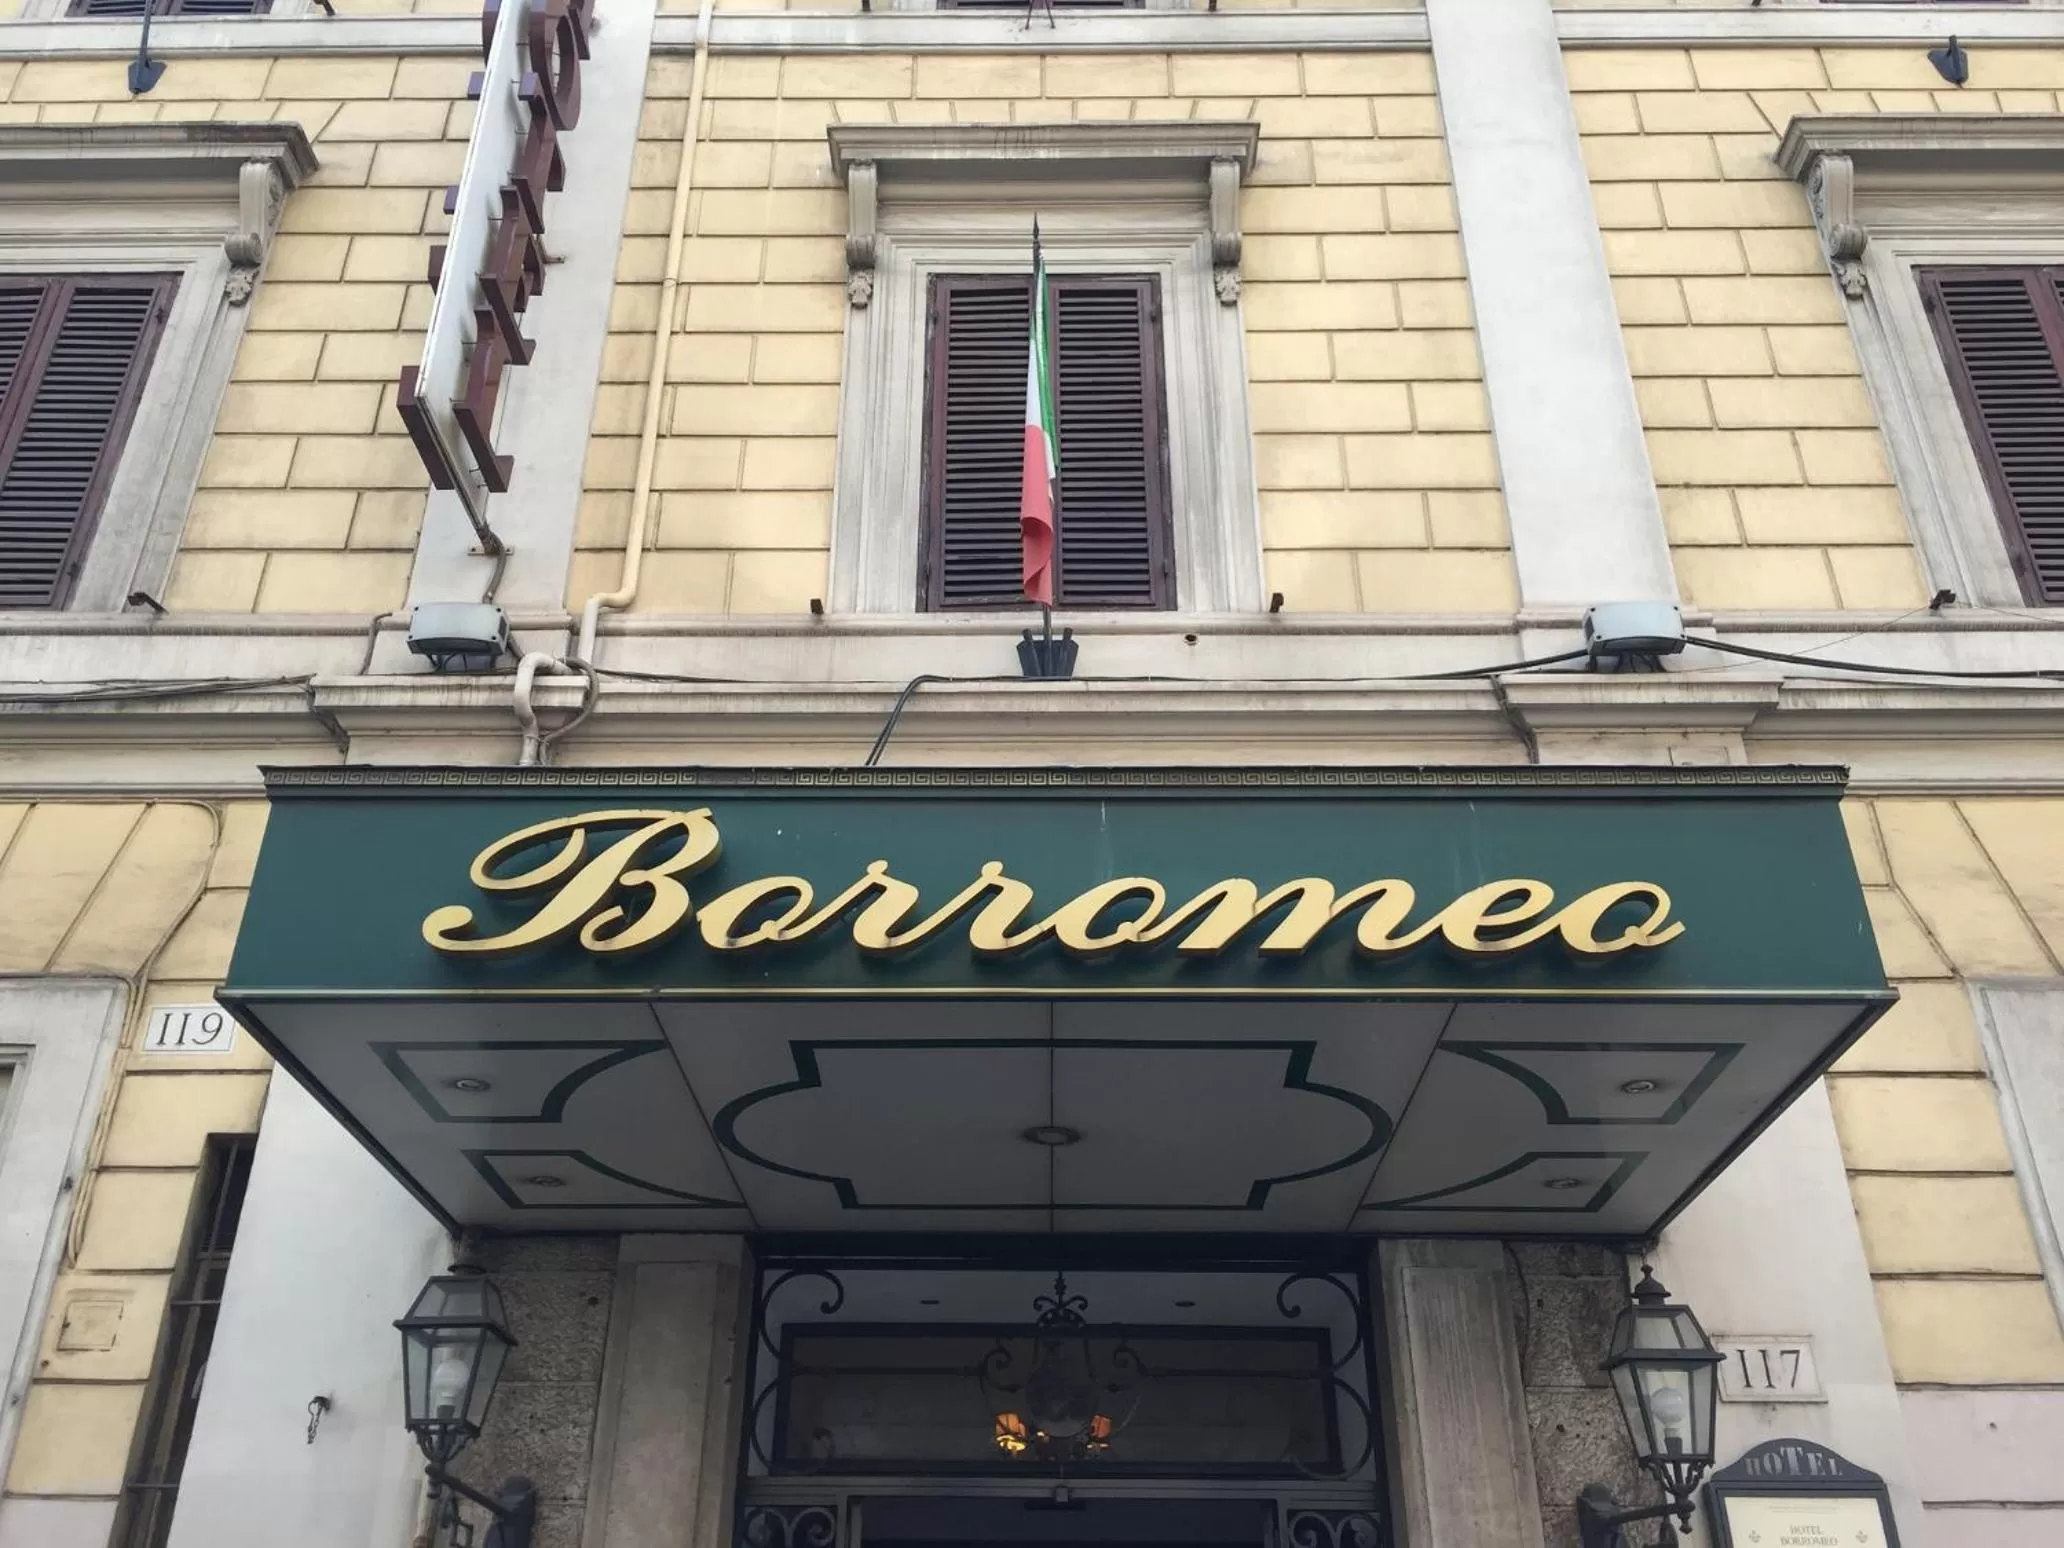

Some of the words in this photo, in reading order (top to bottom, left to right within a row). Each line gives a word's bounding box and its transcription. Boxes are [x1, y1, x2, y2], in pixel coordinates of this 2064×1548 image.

[421, 807, 1686, 953] Borromeo
[156, 1011, 223, 1045] 119
[1736, 1349, 1801, 1389] 117
[1744, 1446, 1844, 1477] HOTEL
[1789, 1524, 1825, 1535] HOTEL
